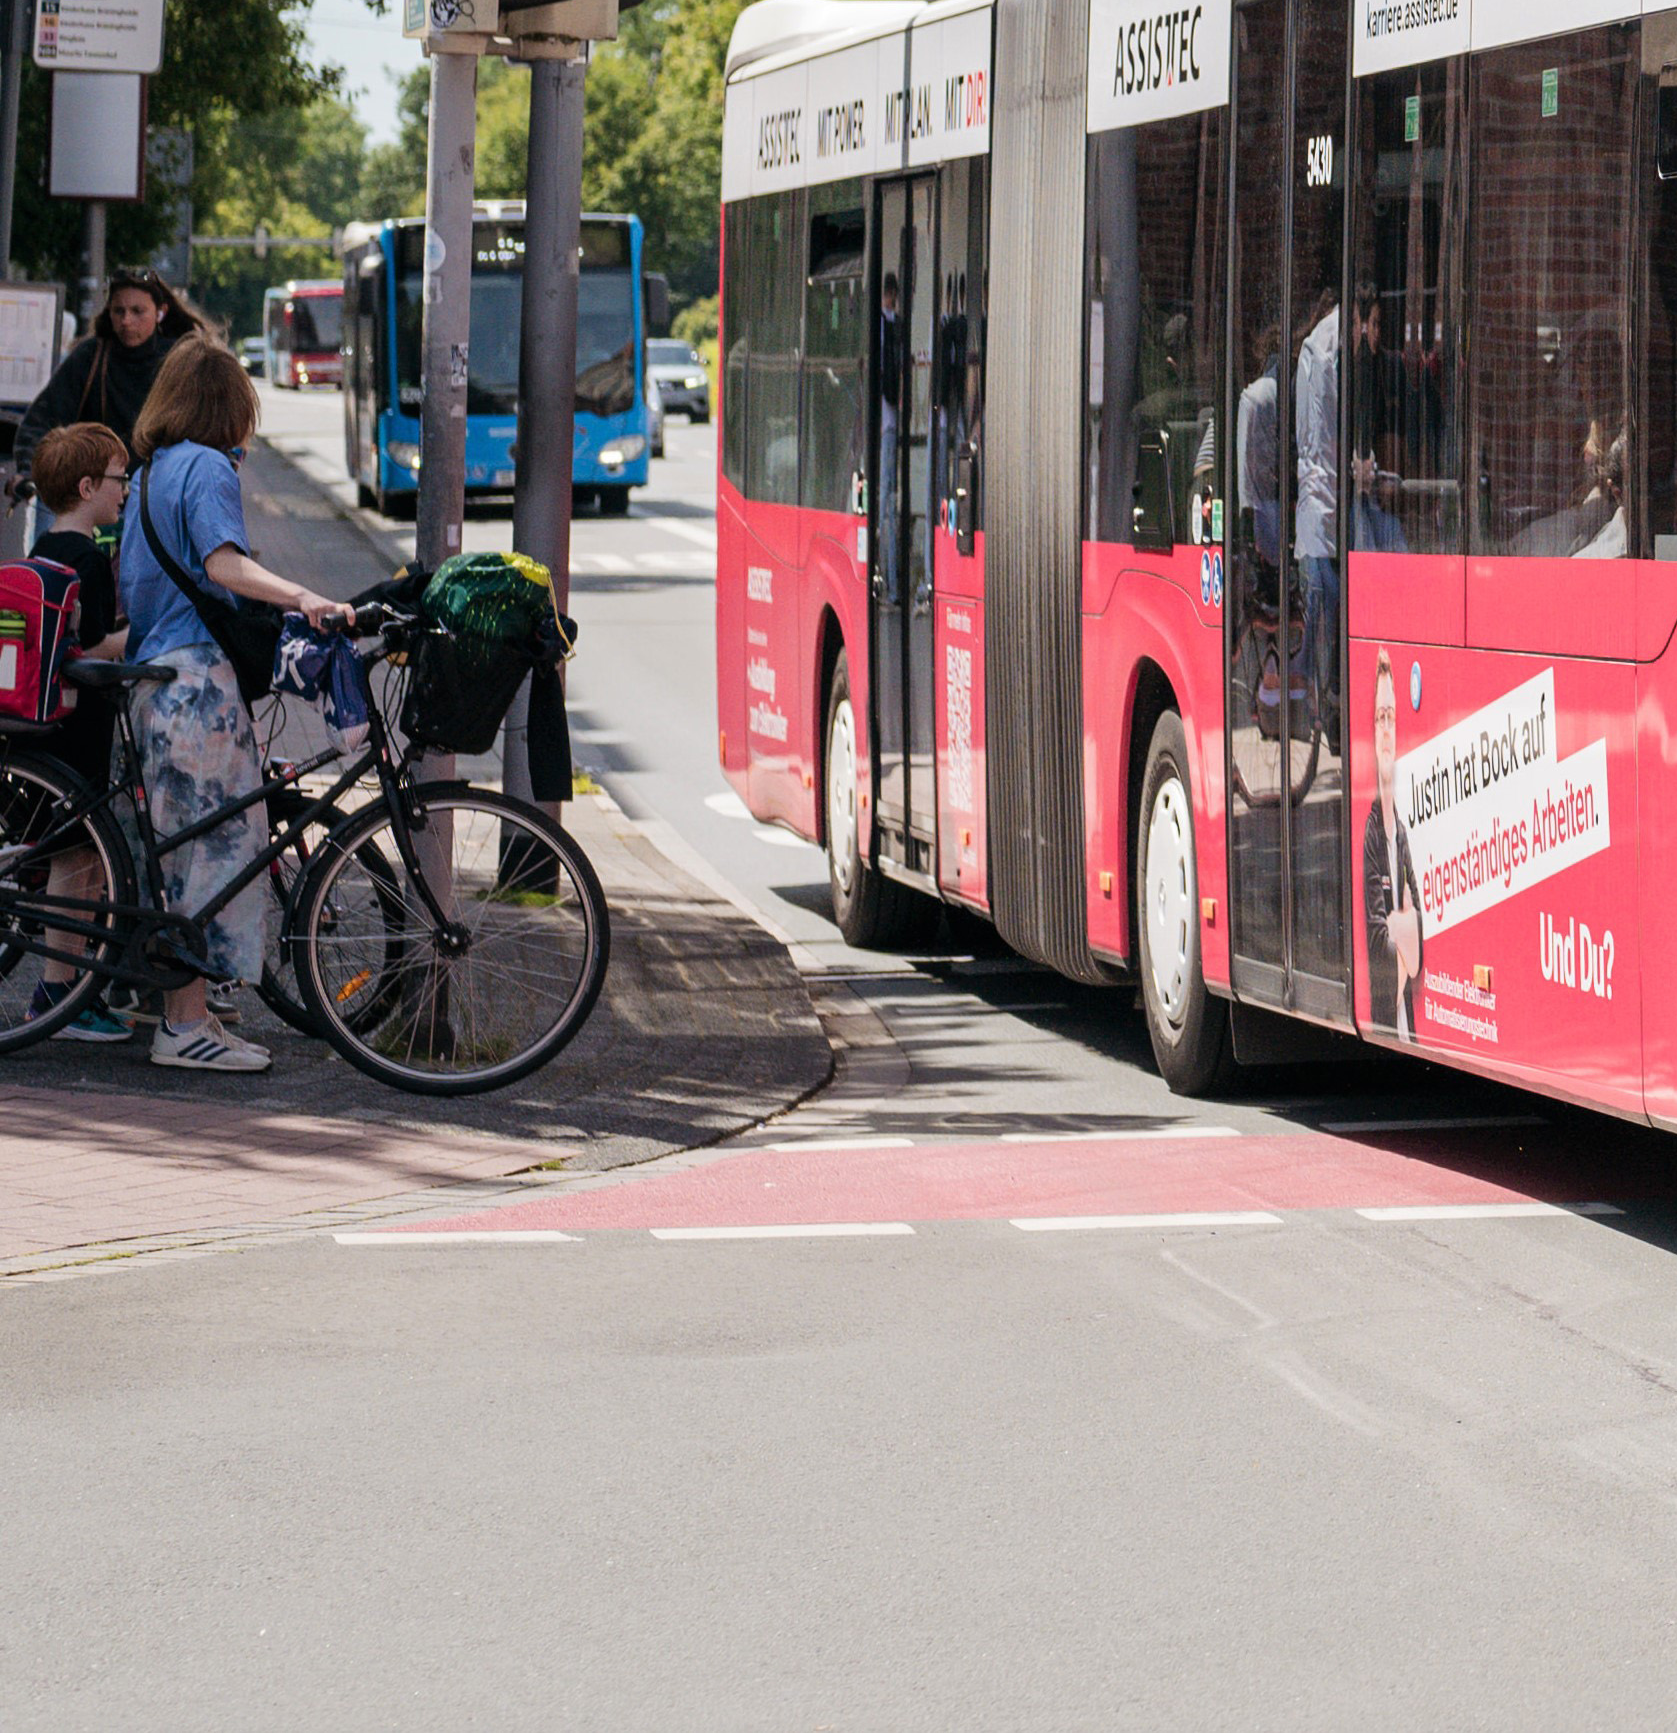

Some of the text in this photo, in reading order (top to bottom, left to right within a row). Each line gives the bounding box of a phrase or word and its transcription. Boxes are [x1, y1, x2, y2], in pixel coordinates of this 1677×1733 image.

[1114, 5, 1202, 97] ASSISTEC
[756, 106, 801, 170] ASSISTEC
[817, 107, 832, 157] MIT
[833, 99, 866, 155] POWER.
[885, 92, 902, 145] MIT
[945, 75, 964, 132] MIT
[966, 69, 987, 128] DIR!
[1307, 135, 1333, 187] 5430
[1408, 692, 1546, 829] Justin hat Bock auf
[1423, 778, 1599, 922] eigenständiges Arbeiten.
[1540, 911, 1615, 1000] Und Du?
[1424, 996, 1435, 1020] für
